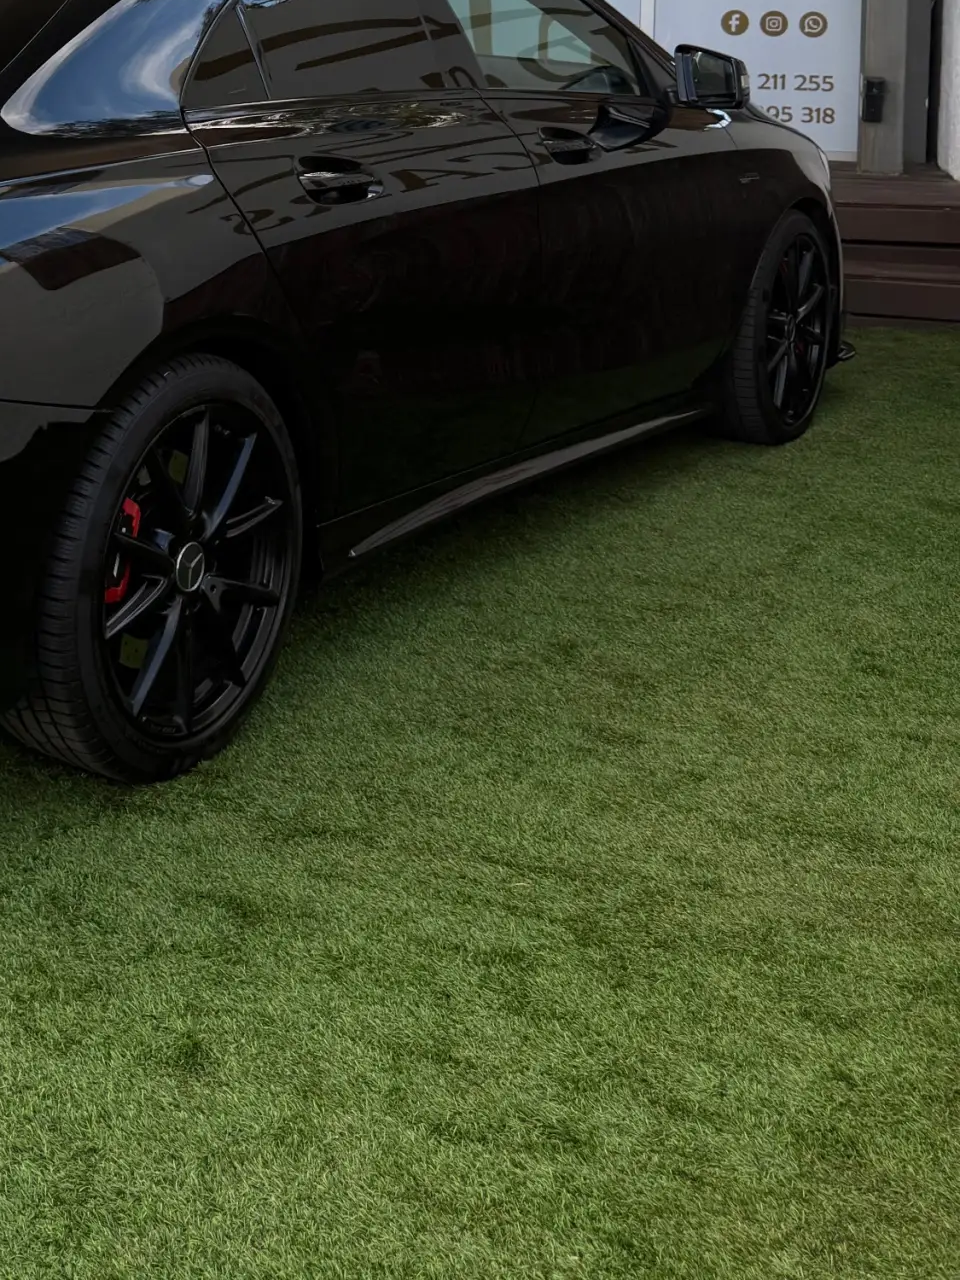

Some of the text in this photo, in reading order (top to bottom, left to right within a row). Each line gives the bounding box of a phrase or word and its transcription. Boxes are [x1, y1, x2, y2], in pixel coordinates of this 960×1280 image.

[757, 74, 834, 92] 211 255
[760, 106, 836, 124] 95 318
